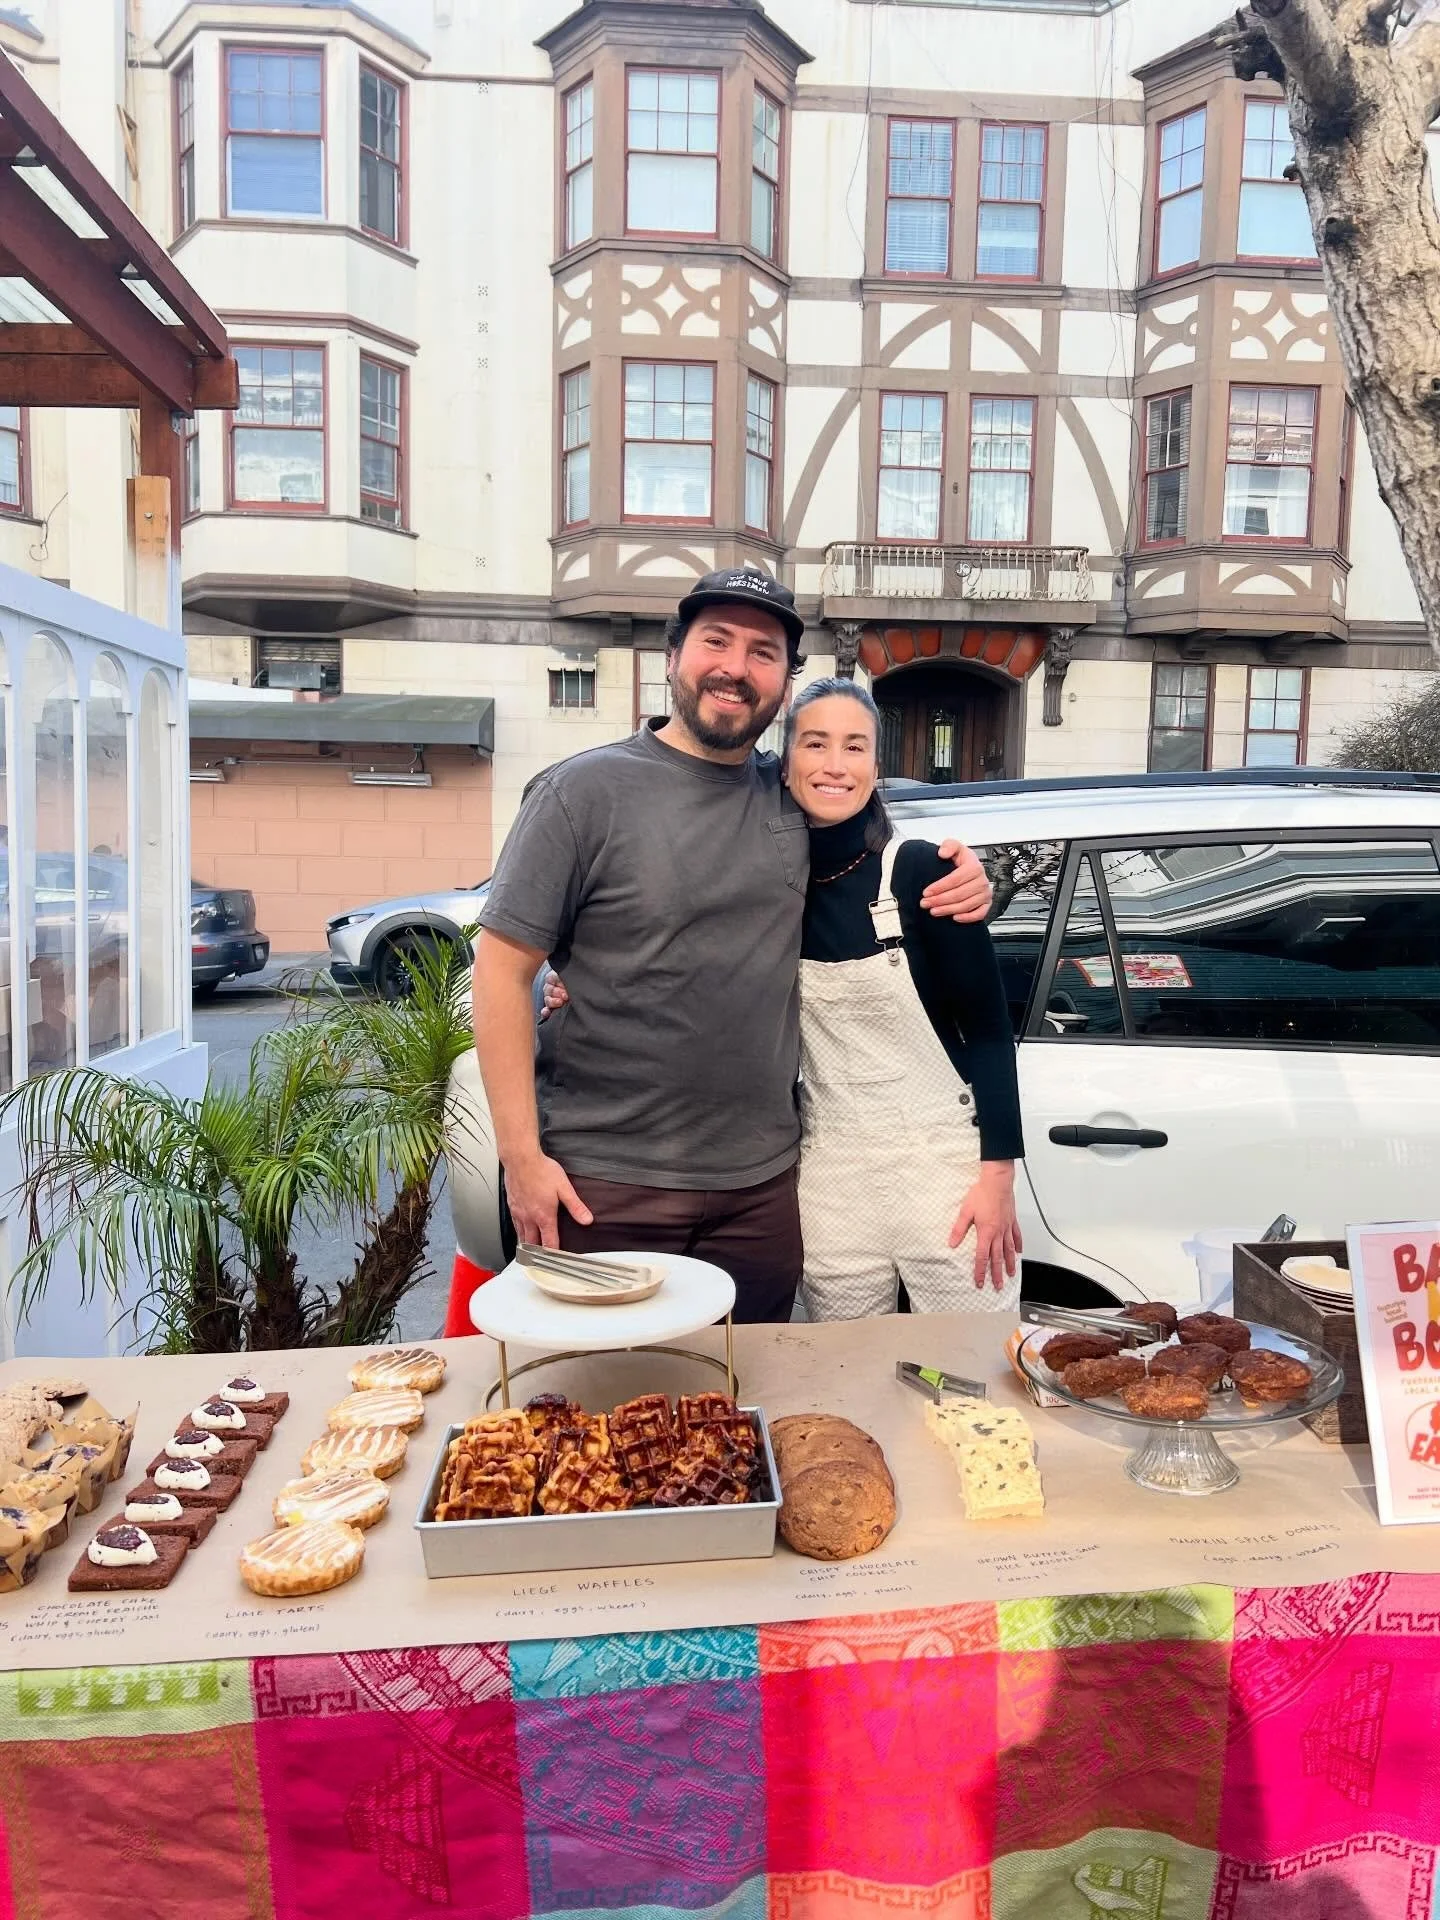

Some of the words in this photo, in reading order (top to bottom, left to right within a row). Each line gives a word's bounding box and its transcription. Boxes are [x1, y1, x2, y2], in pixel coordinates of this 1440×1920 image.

[1234, 1534, 1279, 1544] SPICE
[1285, 1524, 1342, 1537] DONUTS
[977, 1554, 1017, 1564] BROWN
[800, 1566, 841, 1576] CRISPY
[852, 1560, 919, 1570] CHOCOLATE
[995, 1563, 1022, 1571] RICE
[809, 1574, 837, 1582] CHIP
[513, 1584, 559, 1597] LIEGE
[577, 1578, 655, 1591] WAFFLES
[38, 1600, 111, 1611] CHOCOLATE
[122, 1597, 157, 1605] CAKE
[56, 1610, 98, 1619] CREME
[107, 1604, 159, 1615] FRAICHE
[225, 1610, 265, 1619] LIME
[276, 1604, 325, 1615] TARTS
[25, 1620, 58, 1629] WHIP
[77, 1616, 126, 1625] CHERRY
[282, 1624, 320, 1637] gluten)
